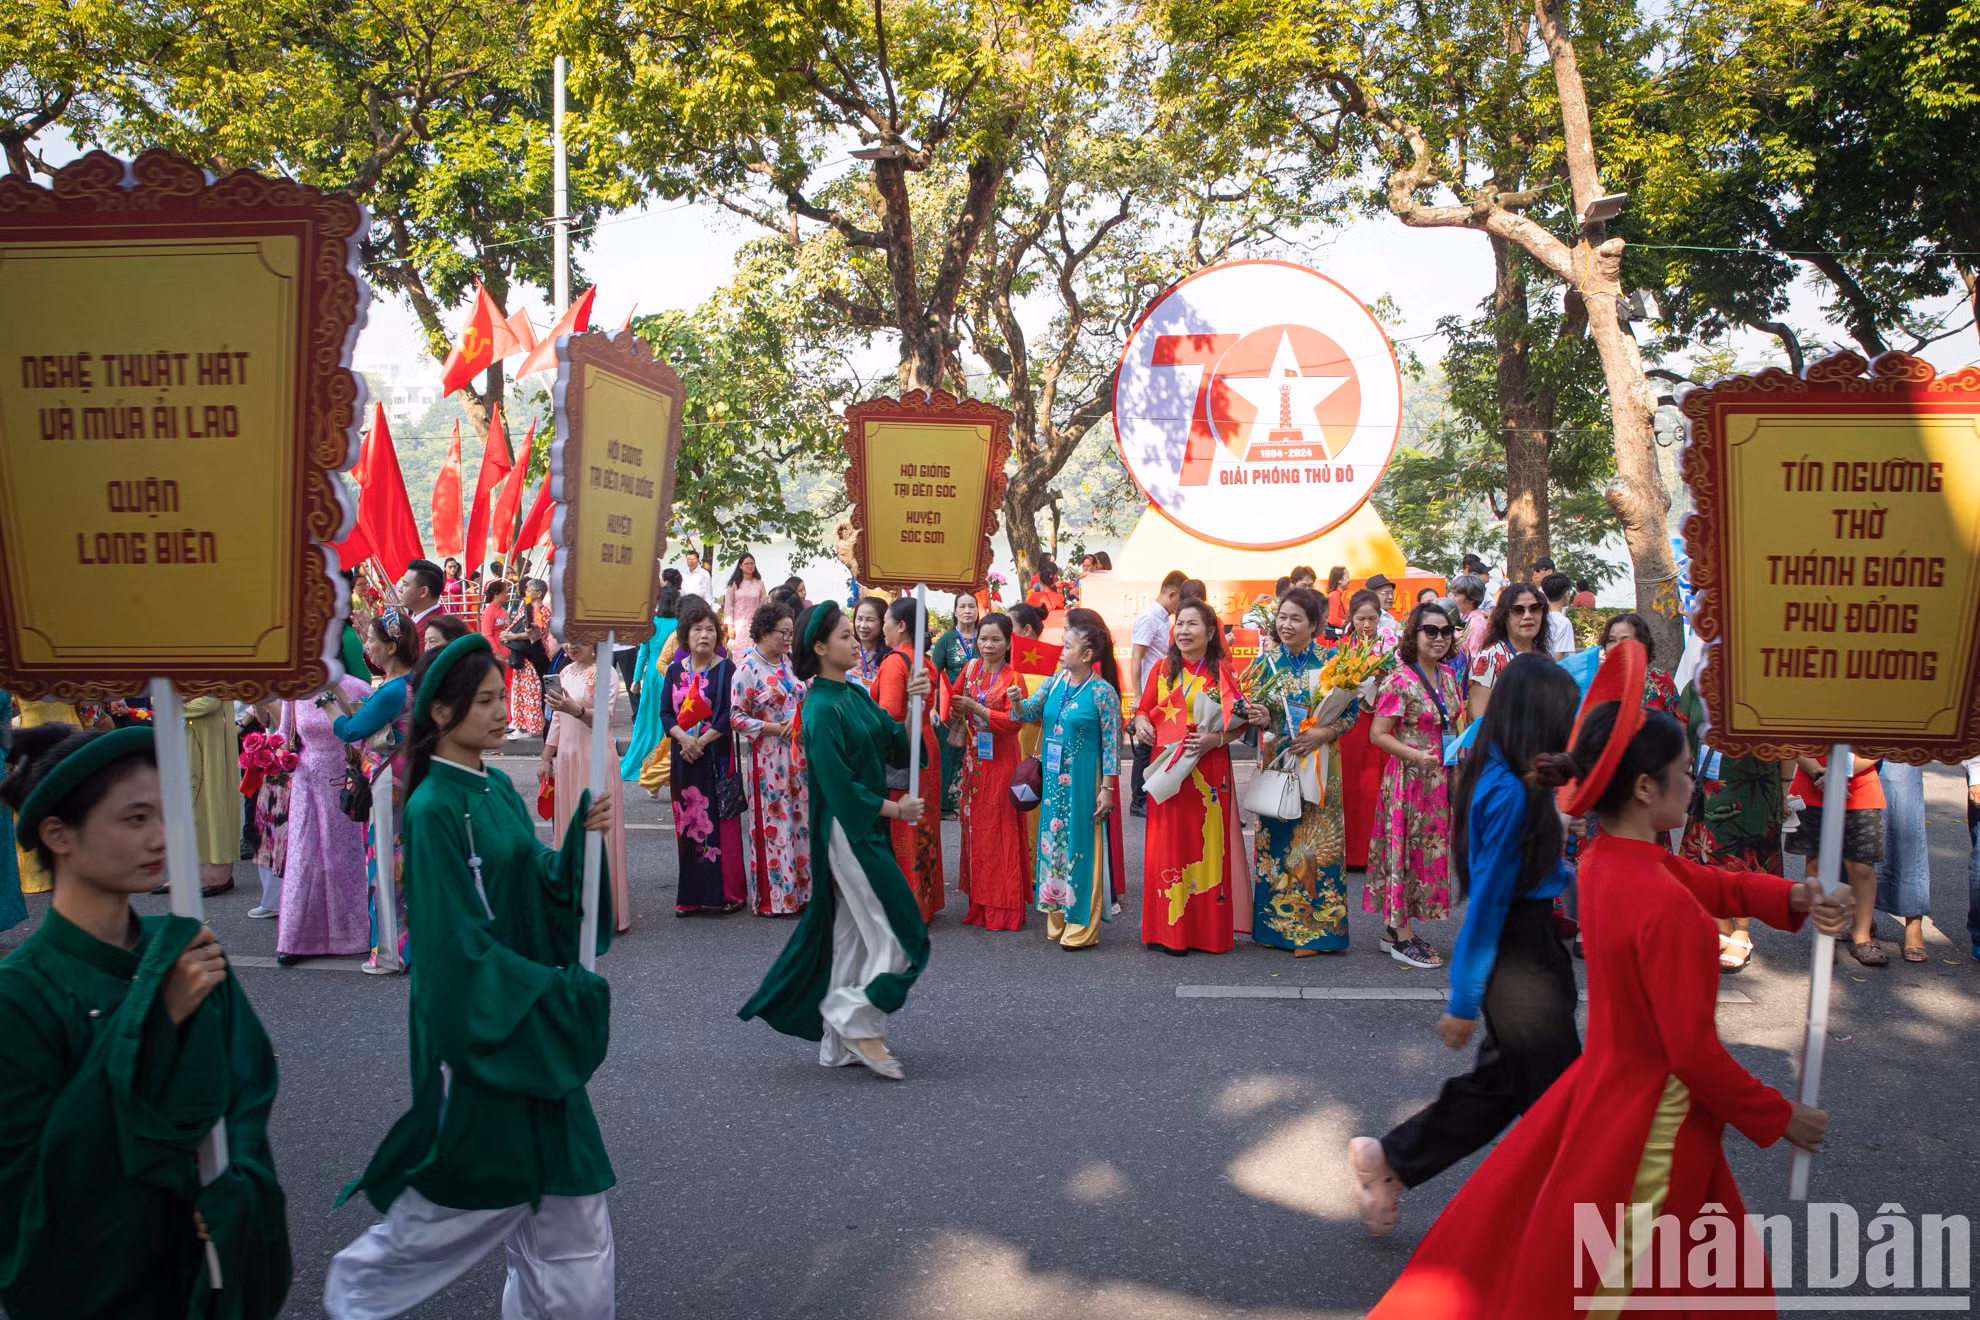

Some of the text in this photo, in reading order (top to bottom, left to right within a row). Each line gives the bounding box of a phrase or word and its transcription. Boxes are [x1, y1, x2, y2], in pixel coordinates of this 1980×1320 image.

[21, 343, 250, 393] NGHỆ THUẬT HÁT
[82, 399, 145, 440] MÚA
[186, 405, 239, 439] LAO
[900, 462, 950, 479] HỘI GIÓNG
[1220, 464, 1354, 486] GIẢI PHÓNG THỦ ĐÔ
[1781, 454, 1944, 493] TÍN NGƯỠNG
[107, 476, 180, 518] QUẬN
[894, 481, 956, 498] TẠI ĐỀN SÓC
[901, 527, 944, 544] SÓC SƠN
[906, 510, 941, 526] HUYỆN
[1832, 502, 1888, 539] THỜ
[77, 528, 218, 565] LONG BIÊN
[1767, 548, 1946, 588] THÁNH GIÓNG
[1784, 594, 1919, 634] PHÙ ĐỔNG
[1761, 646, 1838, 679] THIÊN
